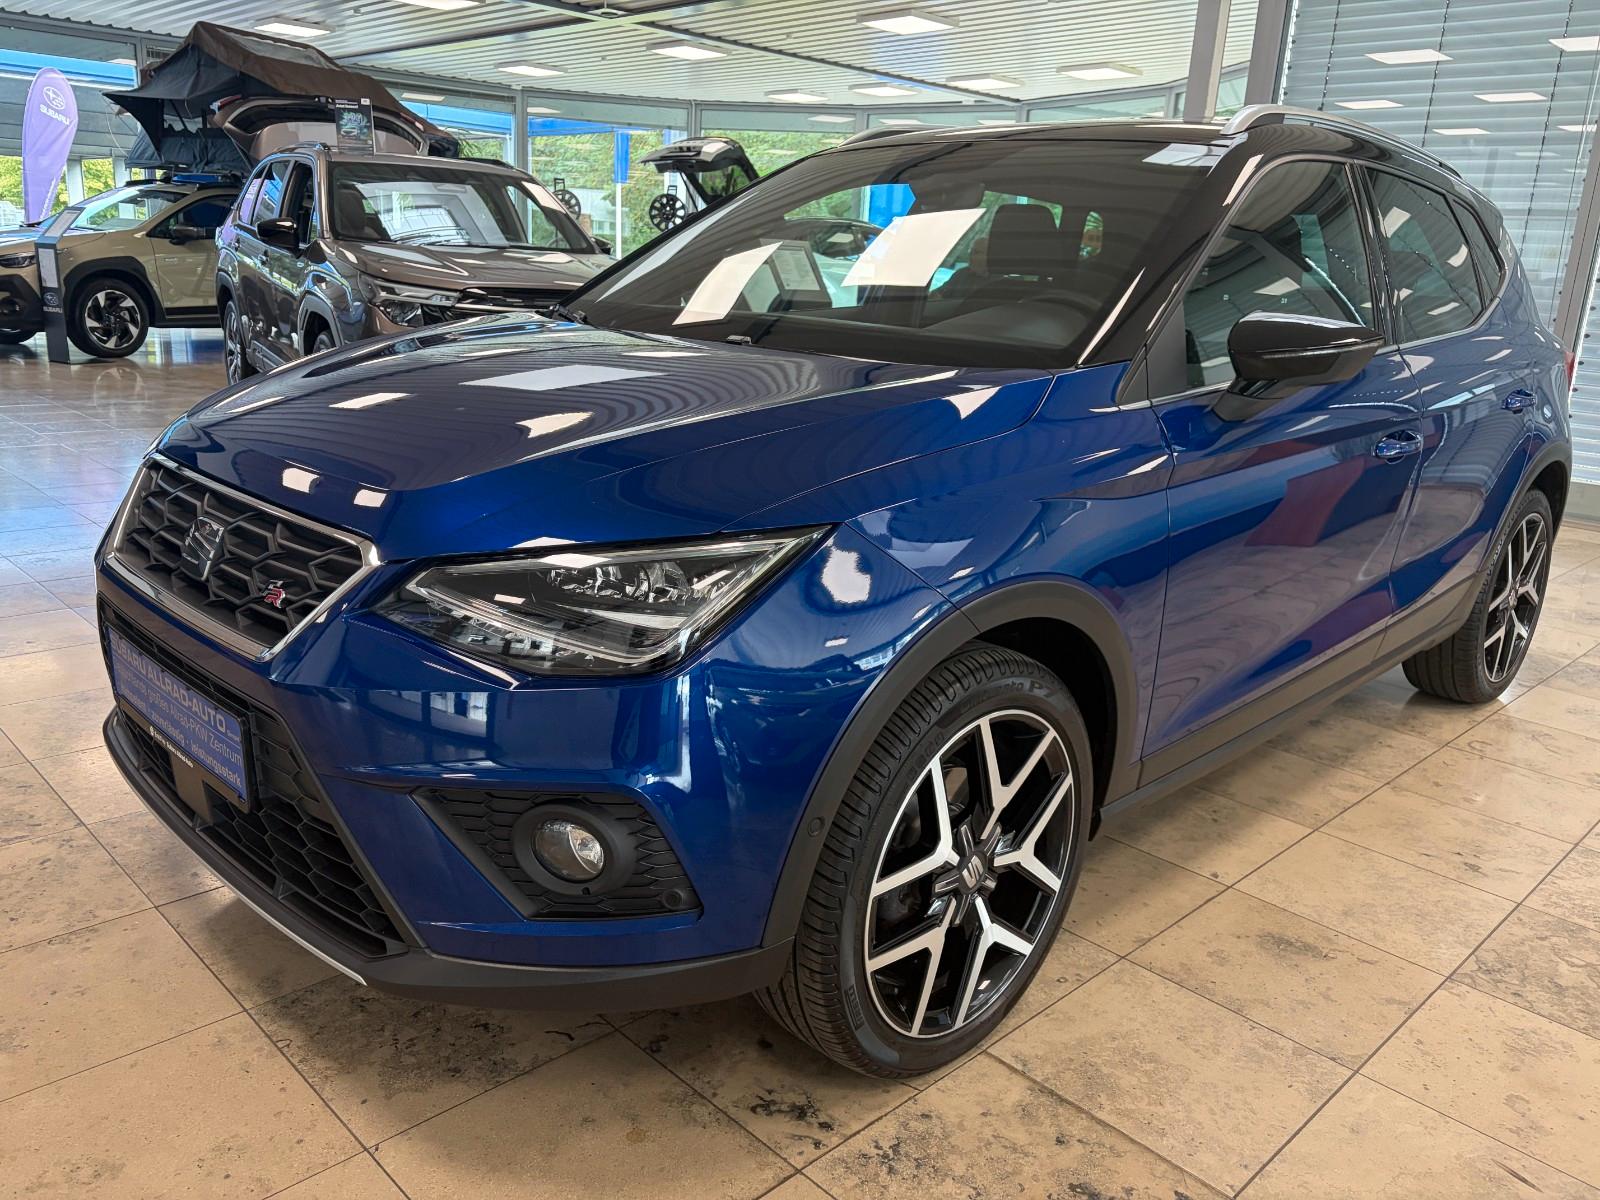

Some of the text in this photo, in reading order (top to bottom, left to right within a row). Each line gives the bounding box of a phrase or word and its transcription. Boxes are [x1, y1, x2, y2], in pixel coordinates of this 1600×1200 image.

[40, 103, 70, 125] SUBARU
[110, 632, 146, 674] SUBARU
[148, 665, 226, 731] ALLRAD-AUTO
[210, 733, 242, 766] Zentrum
